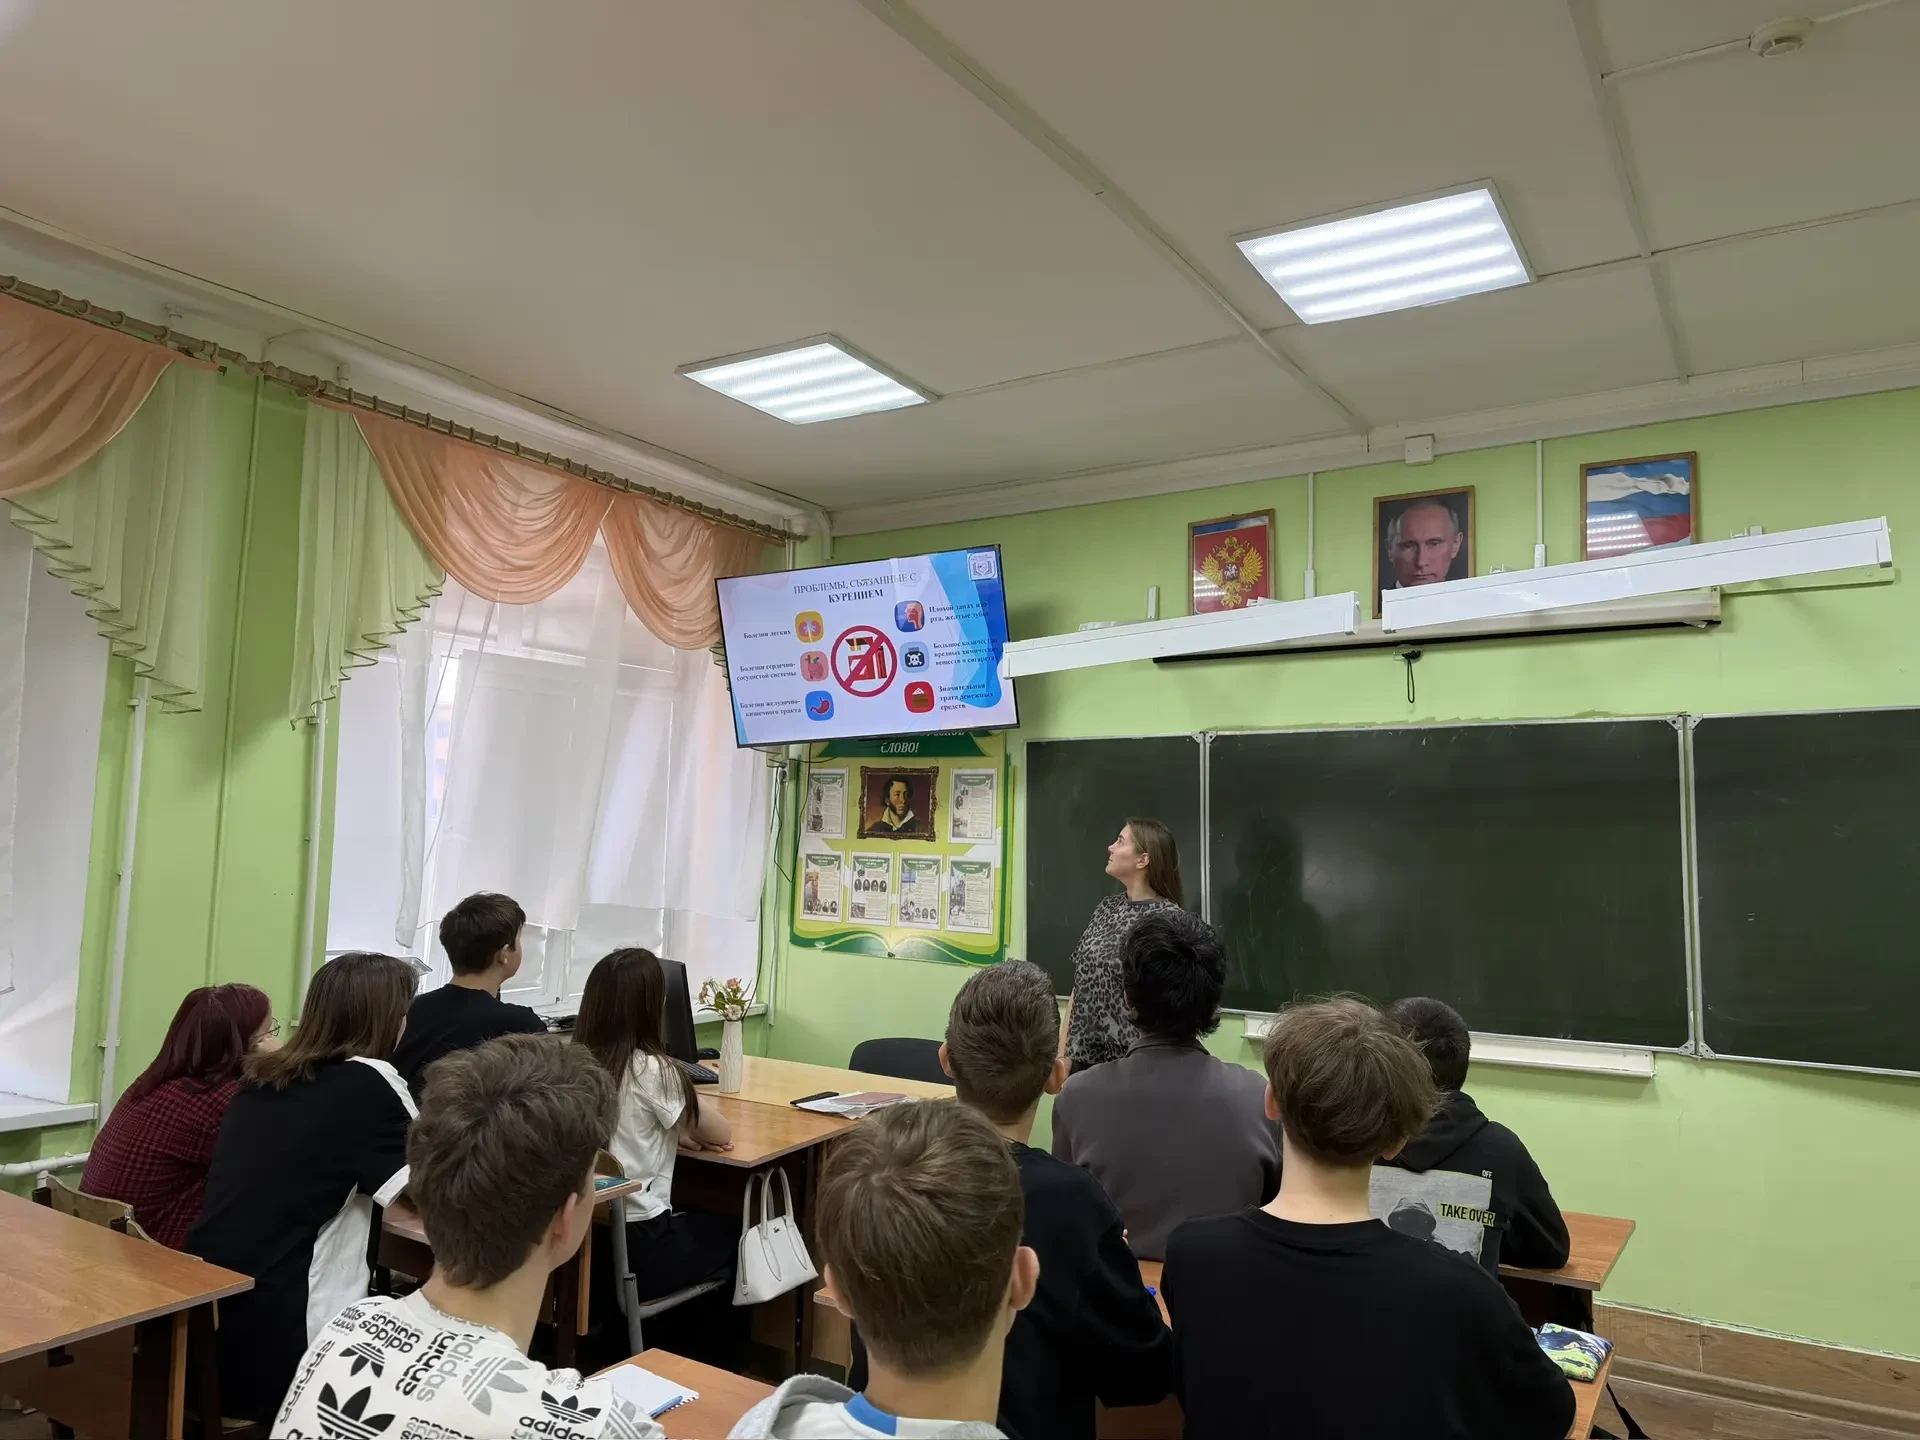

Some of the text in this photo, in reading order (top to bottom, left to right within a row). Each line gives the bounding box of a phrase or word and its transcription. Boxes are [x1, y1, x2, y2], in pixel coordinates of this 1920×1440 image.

[794, 573, 916, 594] ПРОБЛЕМЫ, СВЯЗАННЫЕ С
[828, 589, 883, 603] КУРЕНИЕМ
[929, 605, 954, 613] Плохой
[740, 662, 796, 672] Болезни сердечно-
[736, 671, 797, 682] сосудистой системы
[939, 683, 986, 693] Значительная
[740, 699, 800, 709] Болезни желудочно-
[940, 695, 959, 703] трата
[745, 708, 801, 717] кишечного тракта
[940, 704, 966, 712] средств
[880, 742, 919, 753] СЛОВО!
[1482, 1170, 1492, 1178] OFF
[1440, 1203, 1493, 1225] TAKE OVER
[358, 1320, 414, 1354] adidas
